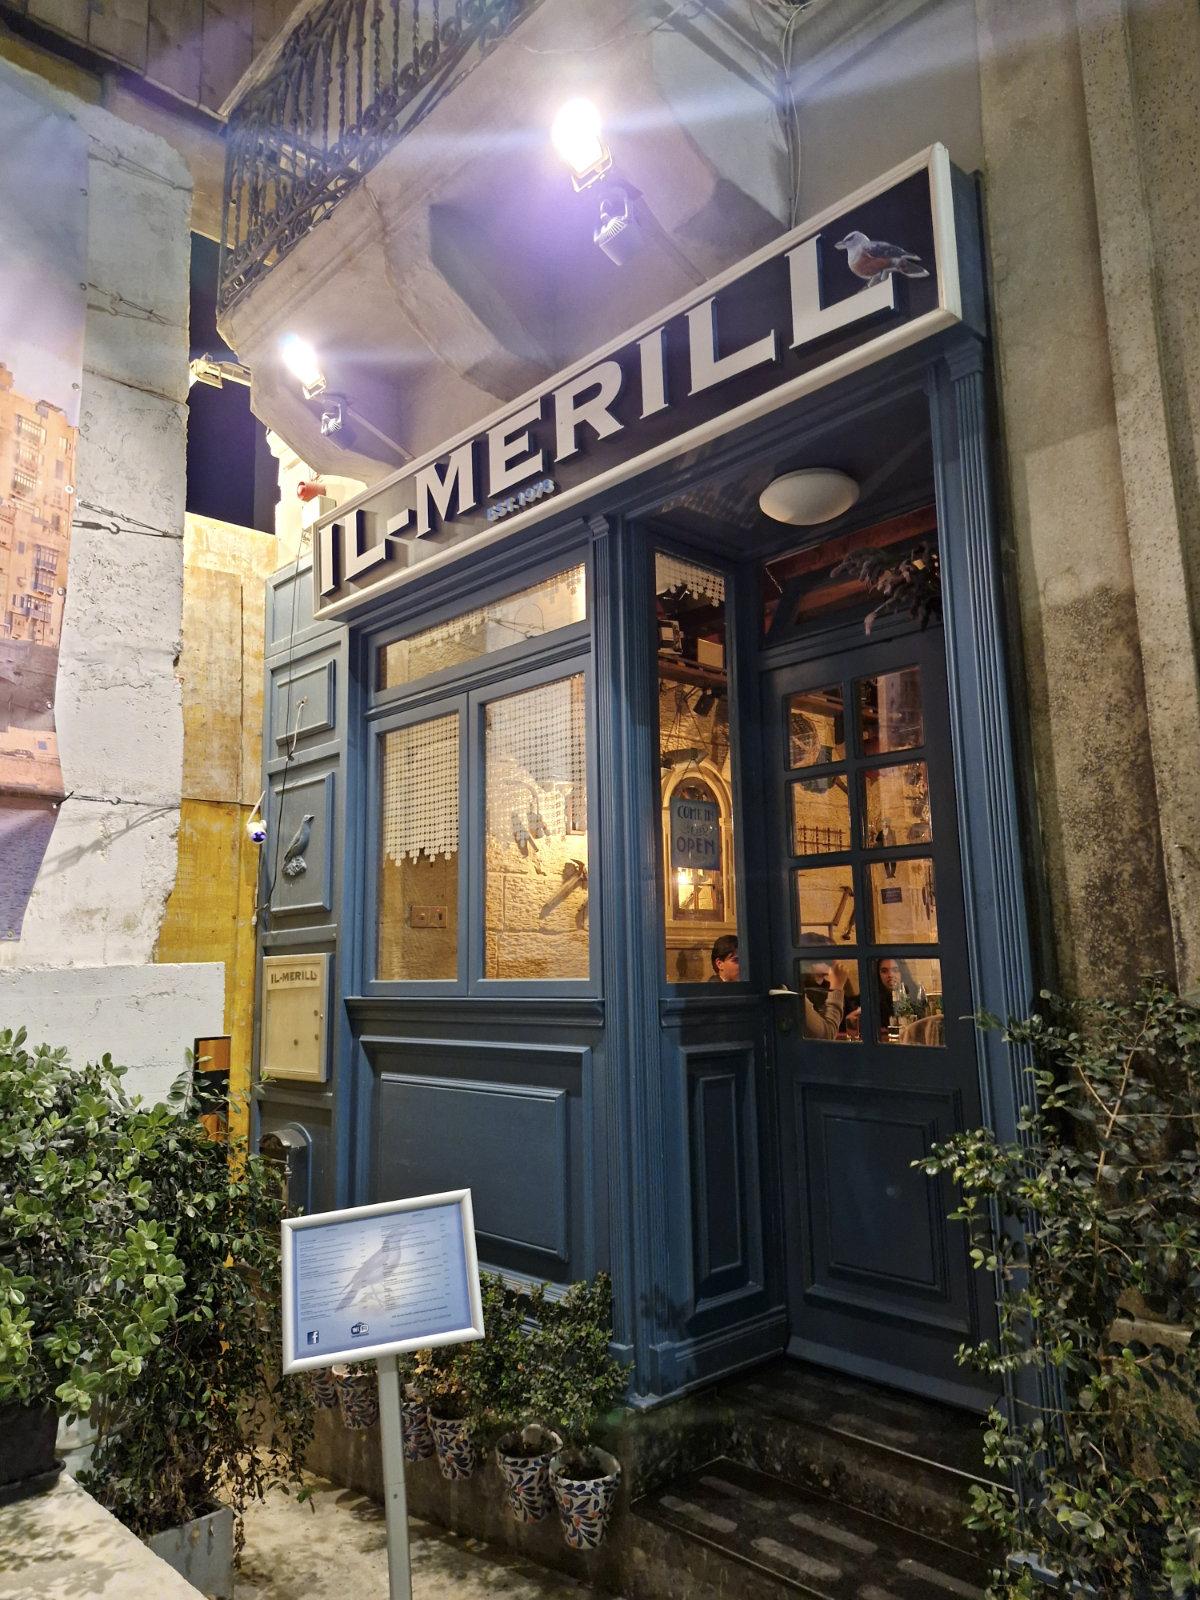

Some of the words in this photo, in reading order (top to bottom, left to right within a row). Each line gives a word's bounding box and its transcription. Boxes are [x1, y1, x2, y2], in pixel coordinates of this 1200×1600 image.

[319, 233, 895, 596] IL-MERILL
[677, 836, 715, 855] OPEN
[271, 970, 318, 984] IL-MERILL
